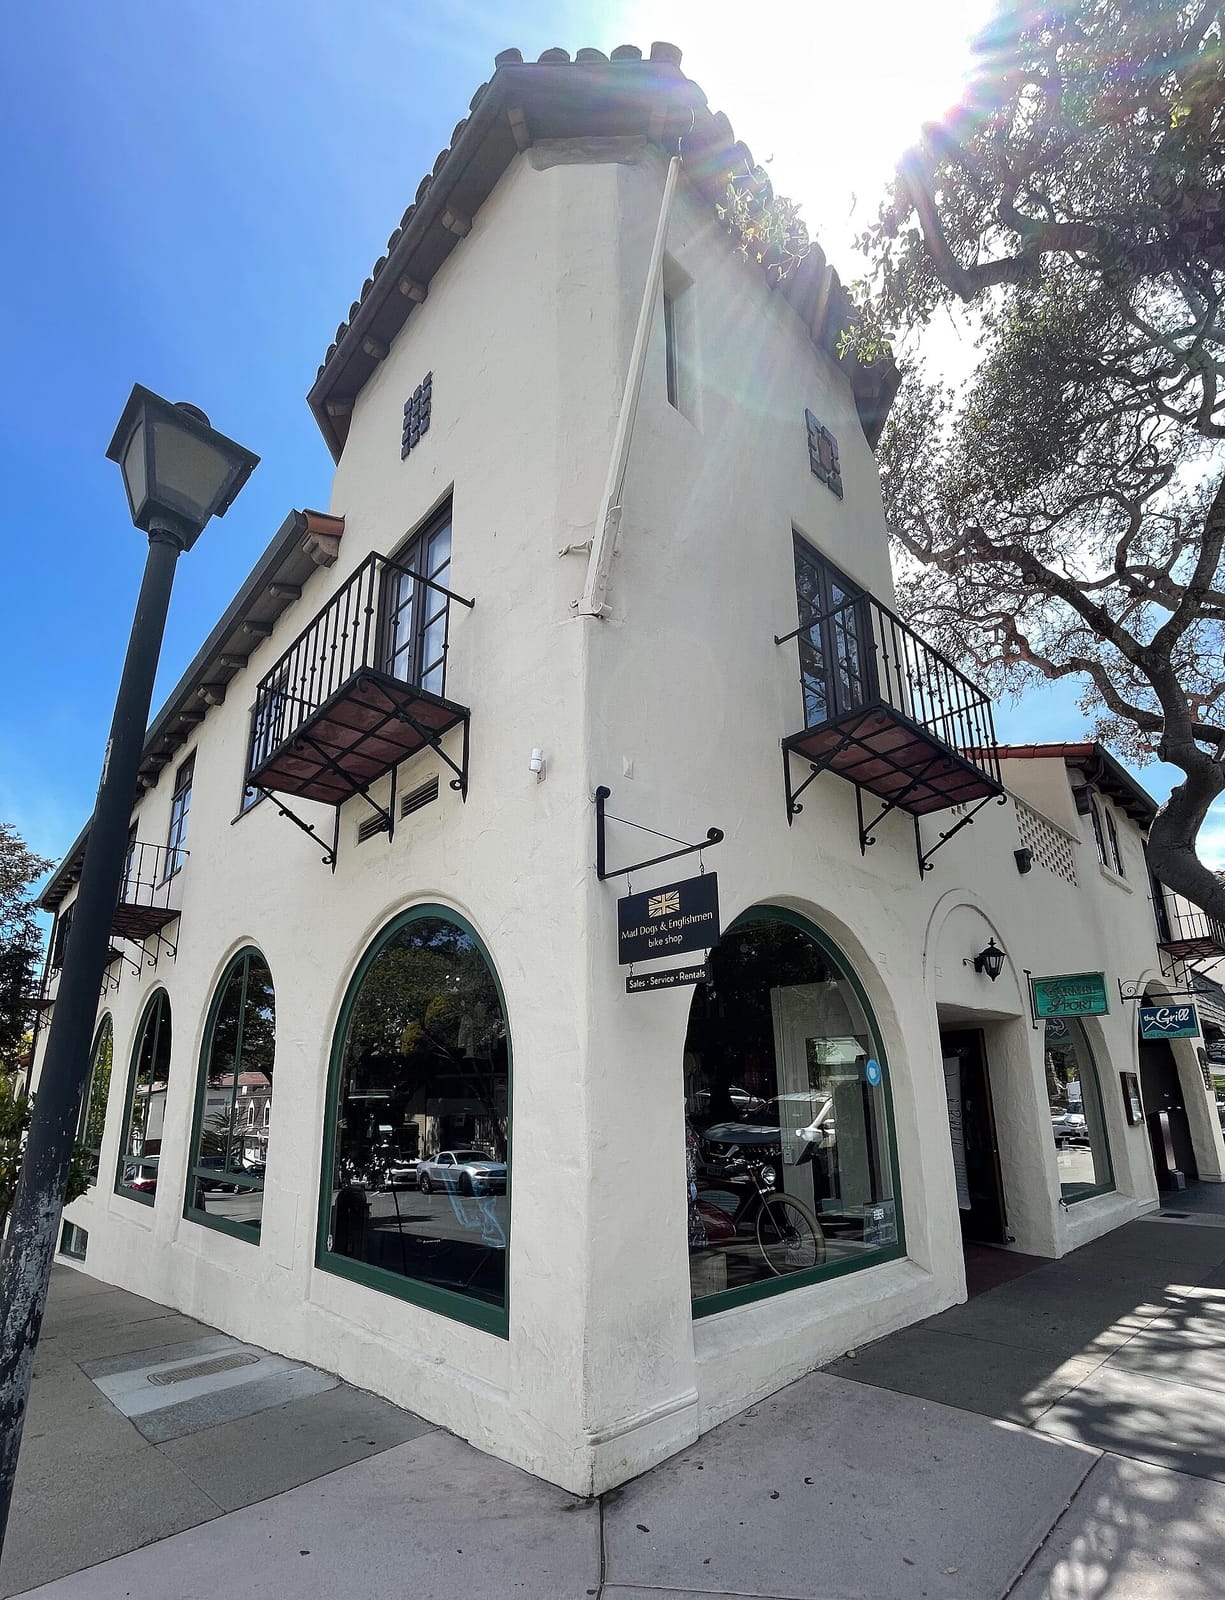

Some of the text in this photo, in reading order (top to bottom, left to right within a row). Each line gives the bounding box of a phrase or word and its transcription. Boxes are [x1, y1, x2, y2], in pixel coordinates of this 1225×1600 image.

[621, 911, 713, 939] Mad Dogs & Englishmen
[648, 934, 683, 948] bike shop
[629, 969, 706, 989] Sales Service Rentals
[1156, 1008, 1189, 1024] Grill
